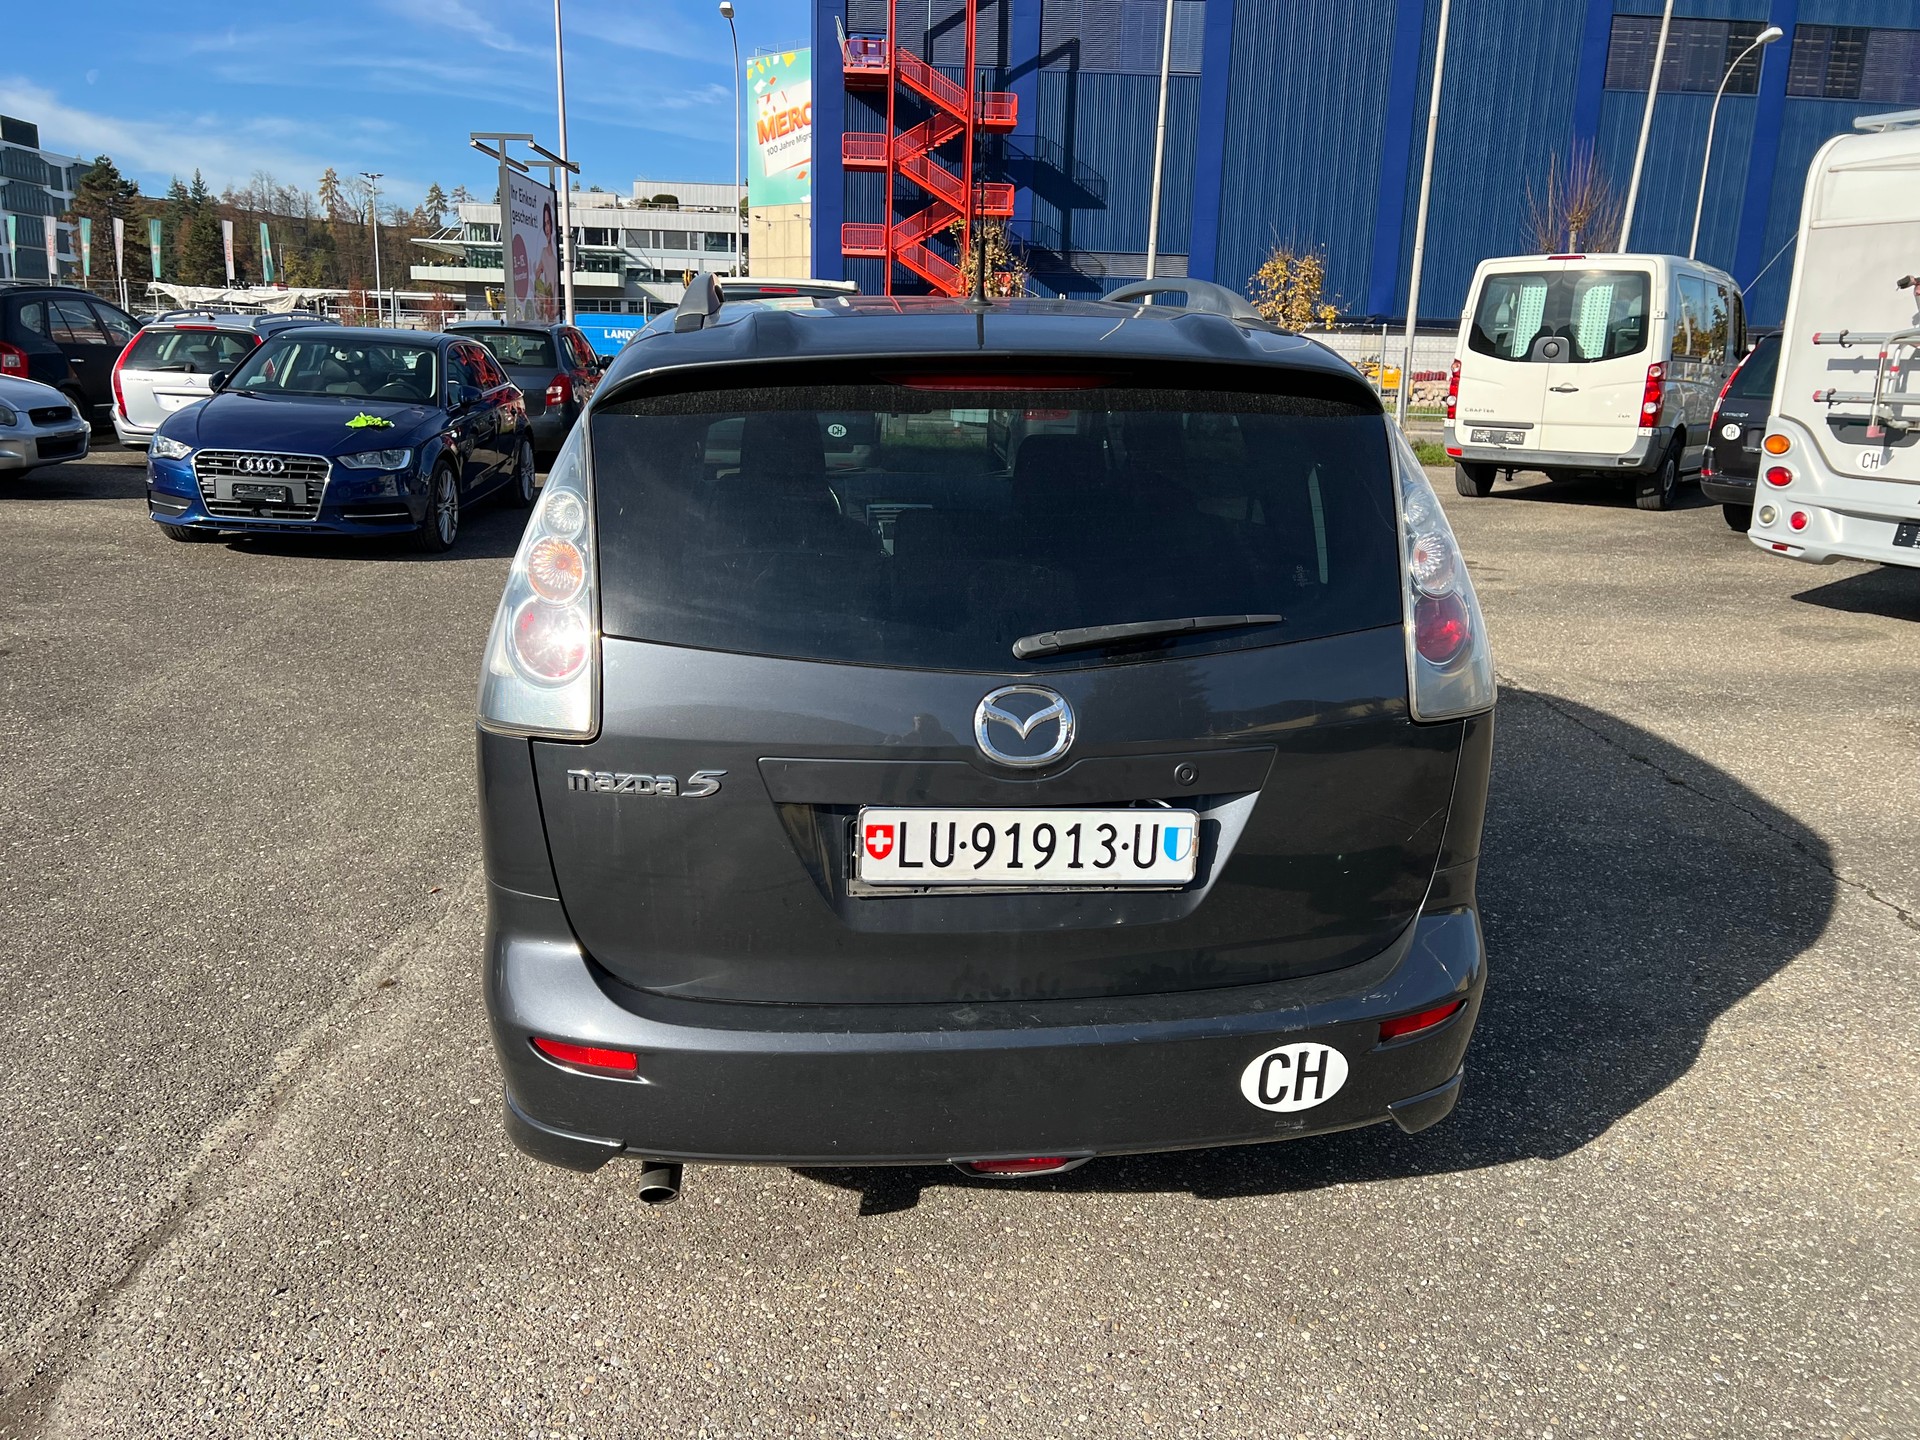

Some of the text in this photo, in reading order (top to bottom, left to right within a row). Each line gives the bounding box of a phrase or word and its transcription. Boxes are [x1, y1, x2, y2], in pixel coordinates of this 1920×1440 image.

[767, 145, 778, 156] 100
[779, 139, 795, 151] Jahre
[518, 187, 537, 209] Einkauf
[604, 329, 636, 341] LAND
[832, 425, 843, 436] CH
[1725, 426, 1737, 438] CH
[1861, 452, 1880, 470] CH
[1258, 1049, 1329, 1105] CH
